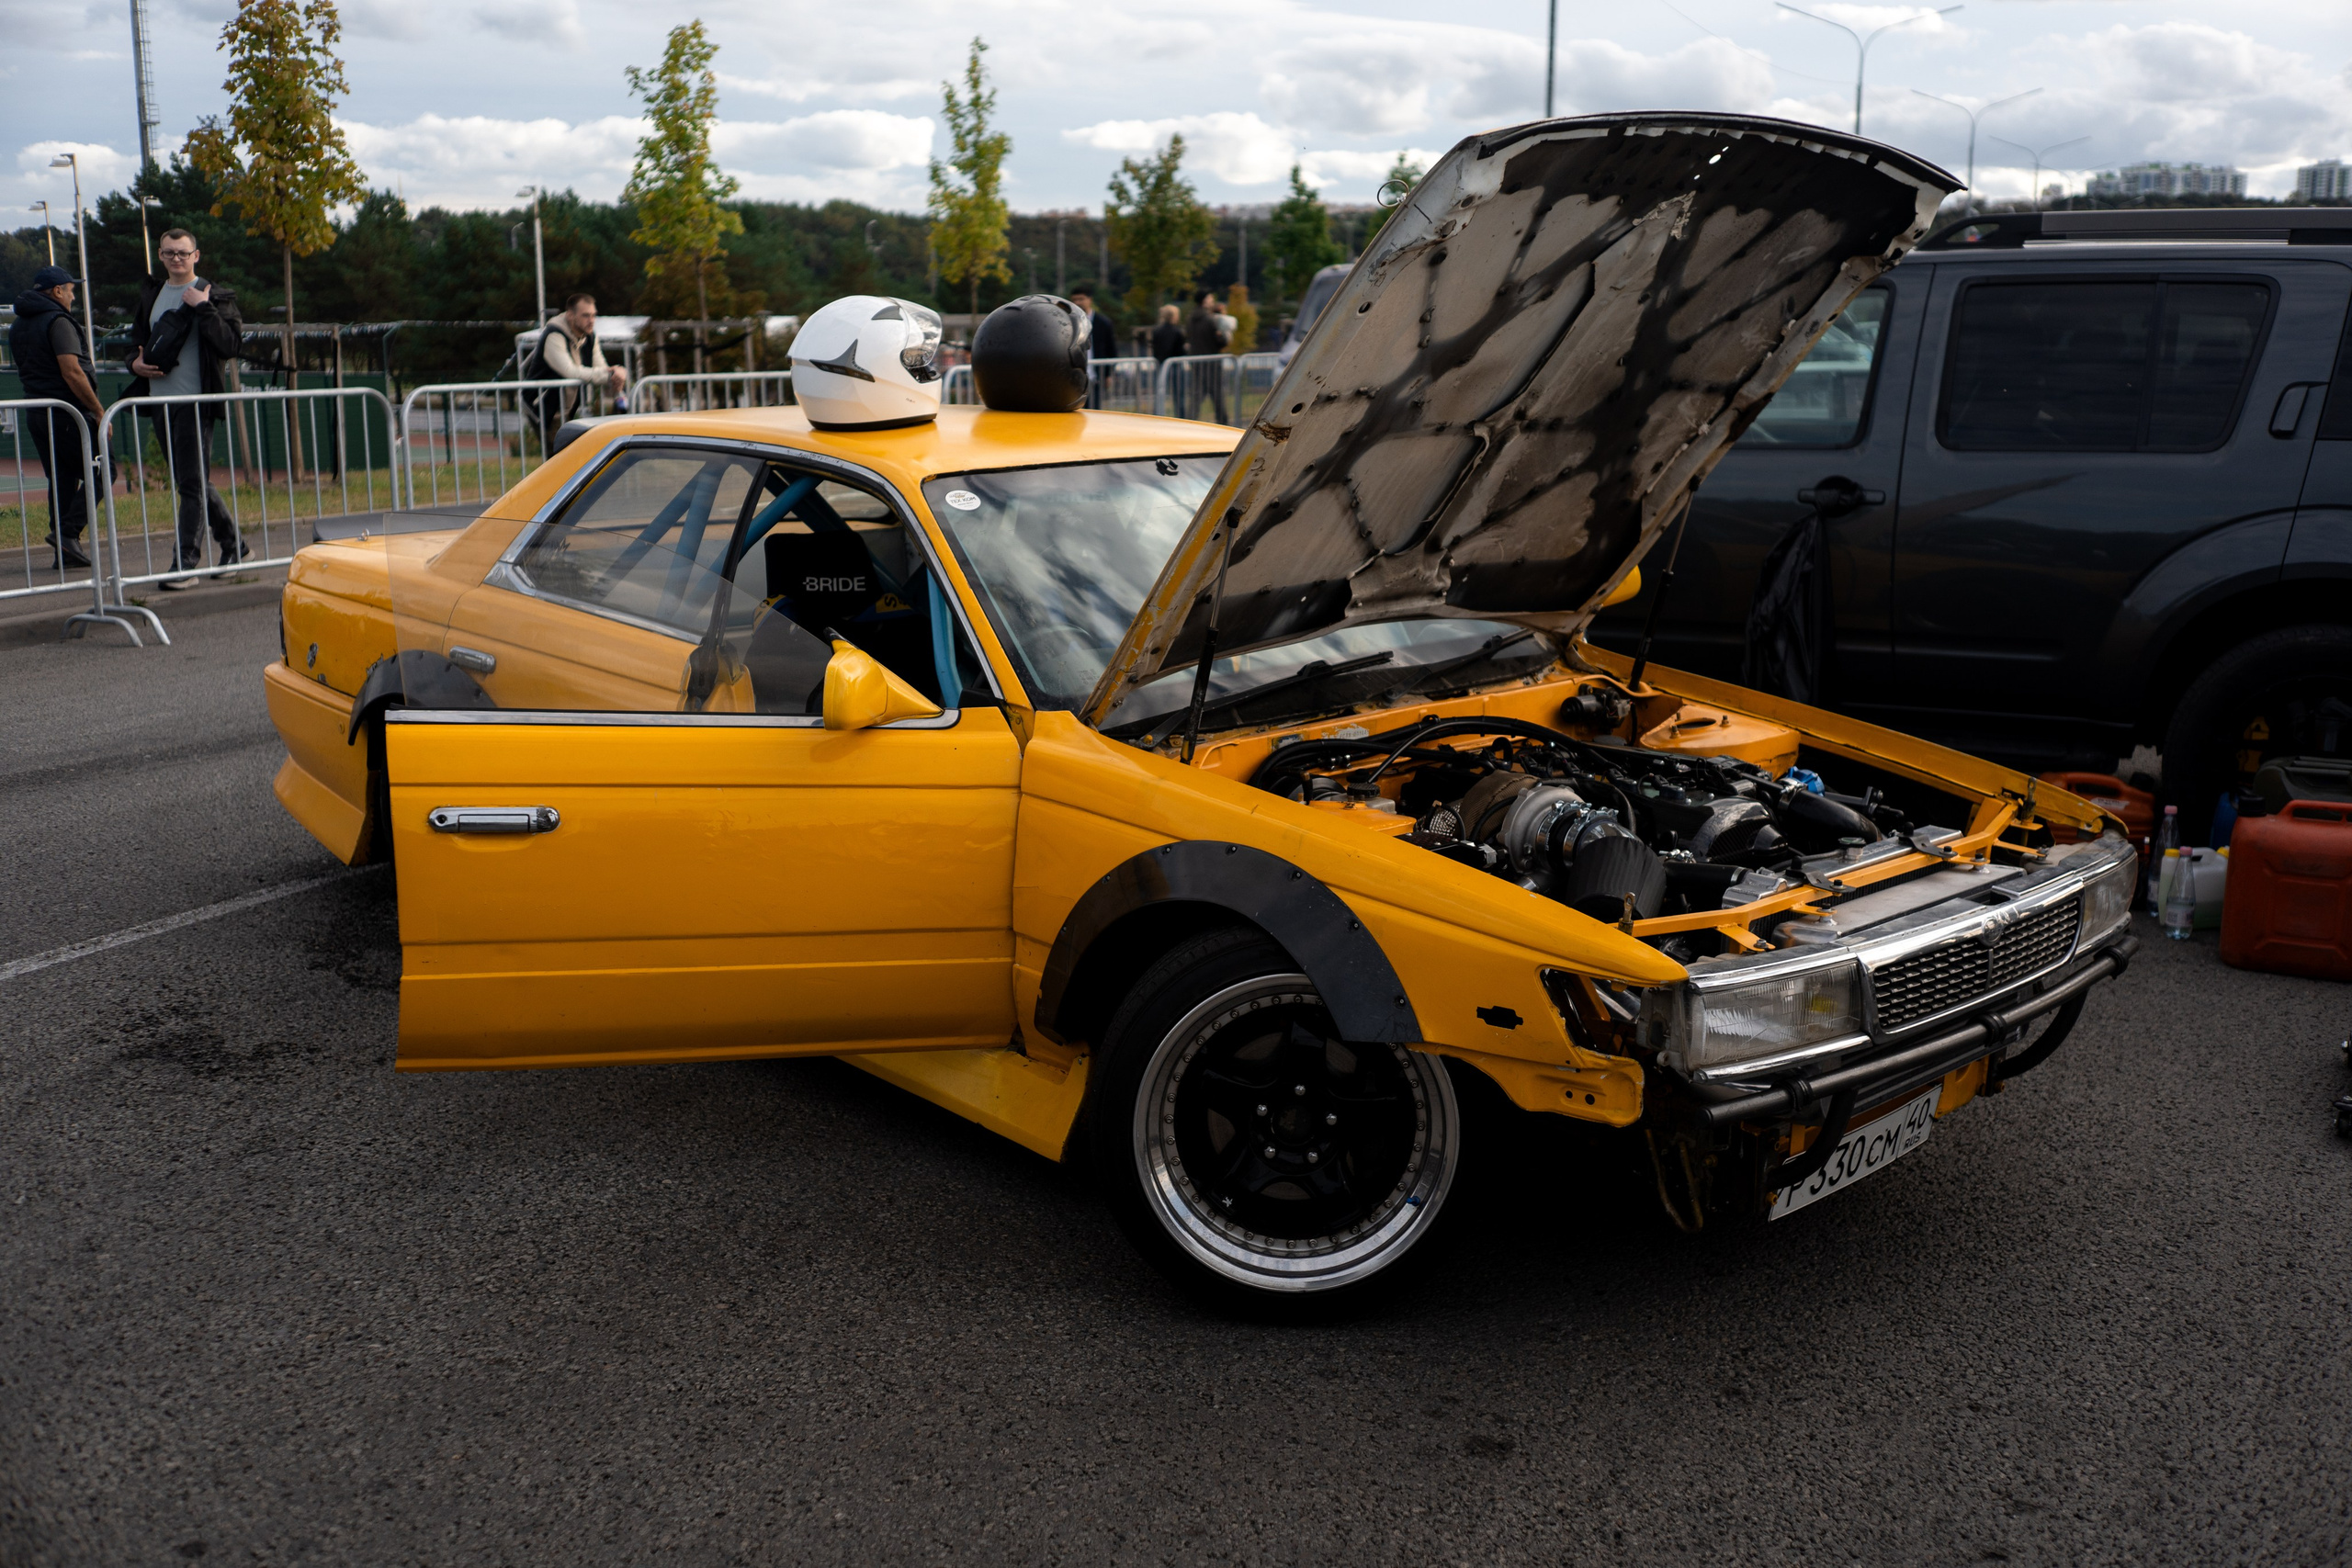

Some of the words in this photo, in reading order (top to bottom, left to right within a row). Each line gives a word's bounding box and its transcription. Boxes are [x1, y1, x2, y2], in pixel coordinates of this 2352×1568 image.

[803, 576, 866, 592] BRIDE
[1906, 1098, 1930, 1132] 40
[1904, 1131, 1921, 1149] RUS
